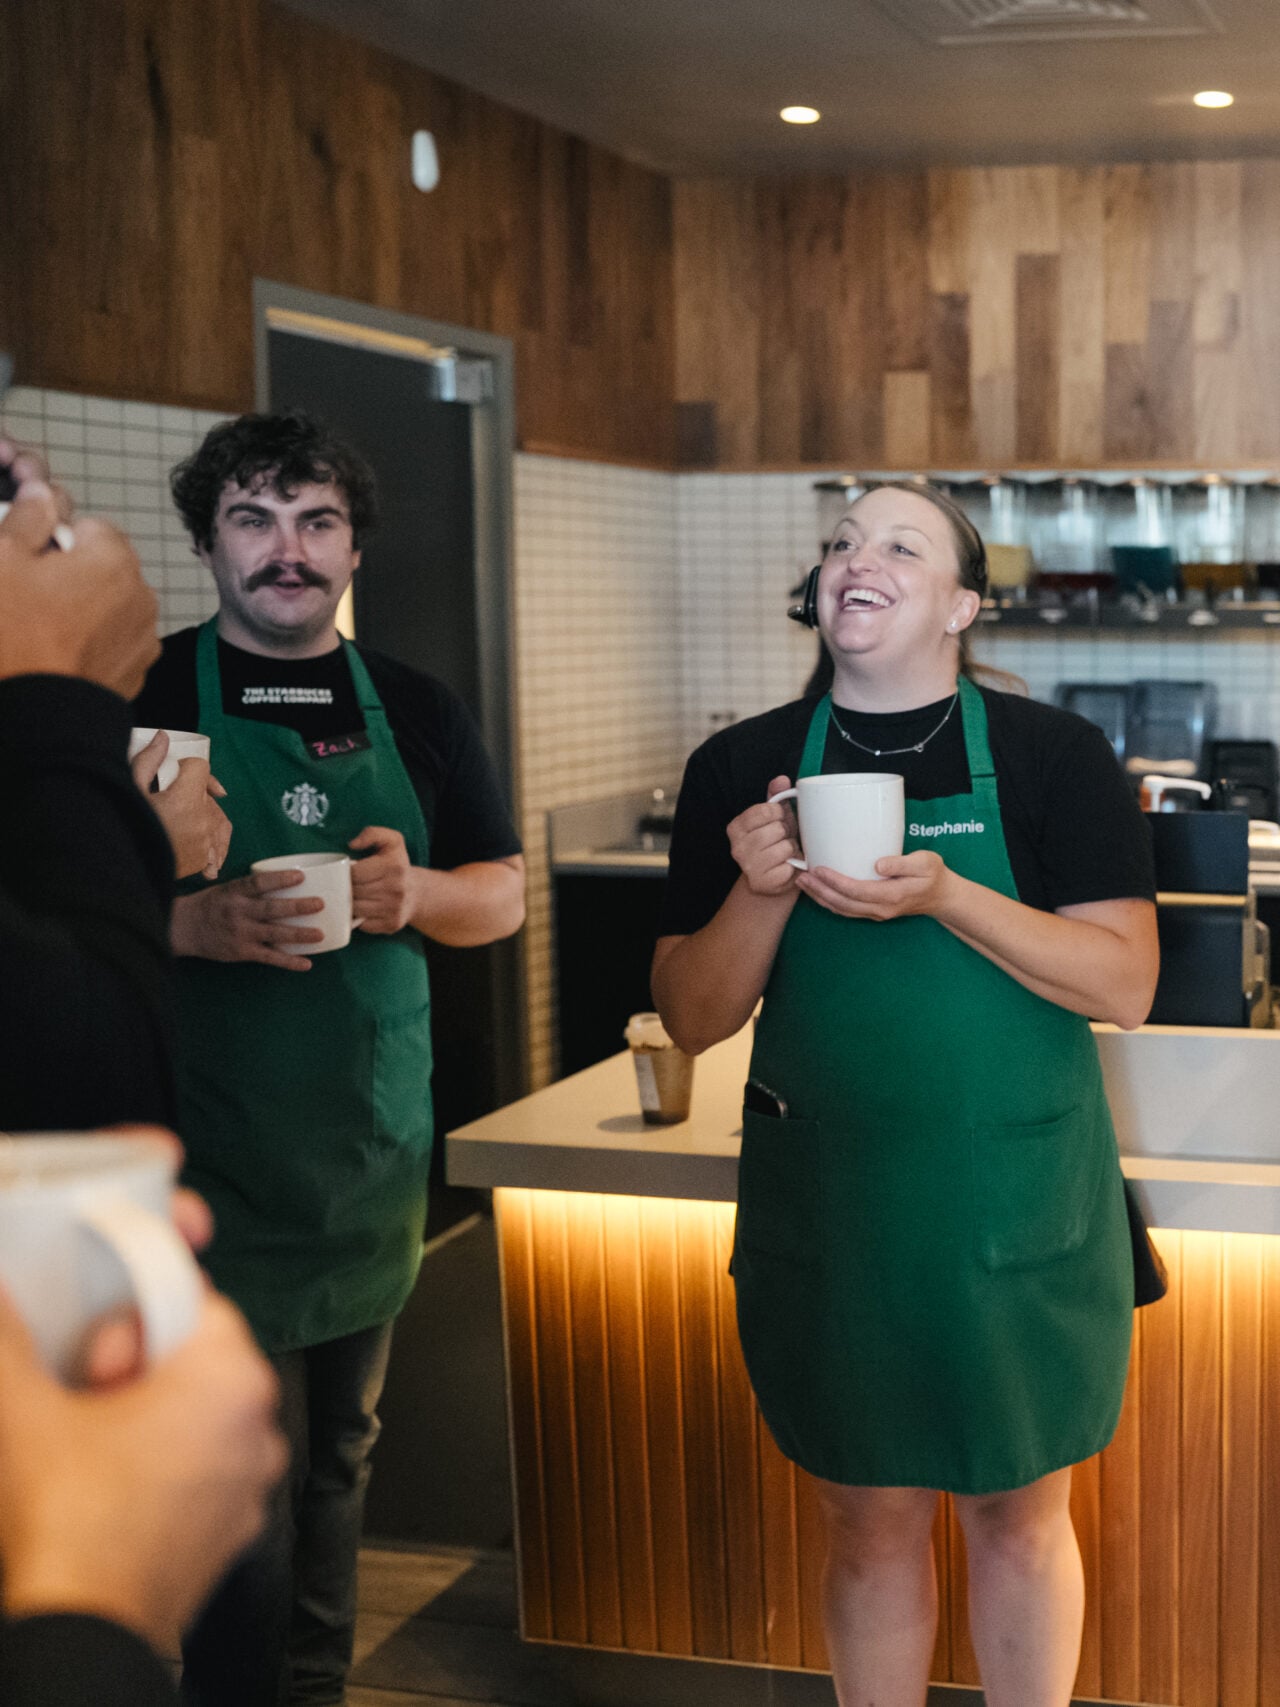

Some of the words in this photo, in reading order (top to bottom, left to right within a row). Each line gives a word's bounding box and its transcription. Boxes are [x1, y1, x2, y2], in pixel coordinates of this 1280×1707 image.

[243, 687, 265, 696] THE
[267, 687, 332, 696] STARBUCKS
[241, 695, 281, 704] COFFEE
[283, 695, 334, 704] COMPANY
[908, 819, 985, 837] Stephanie
